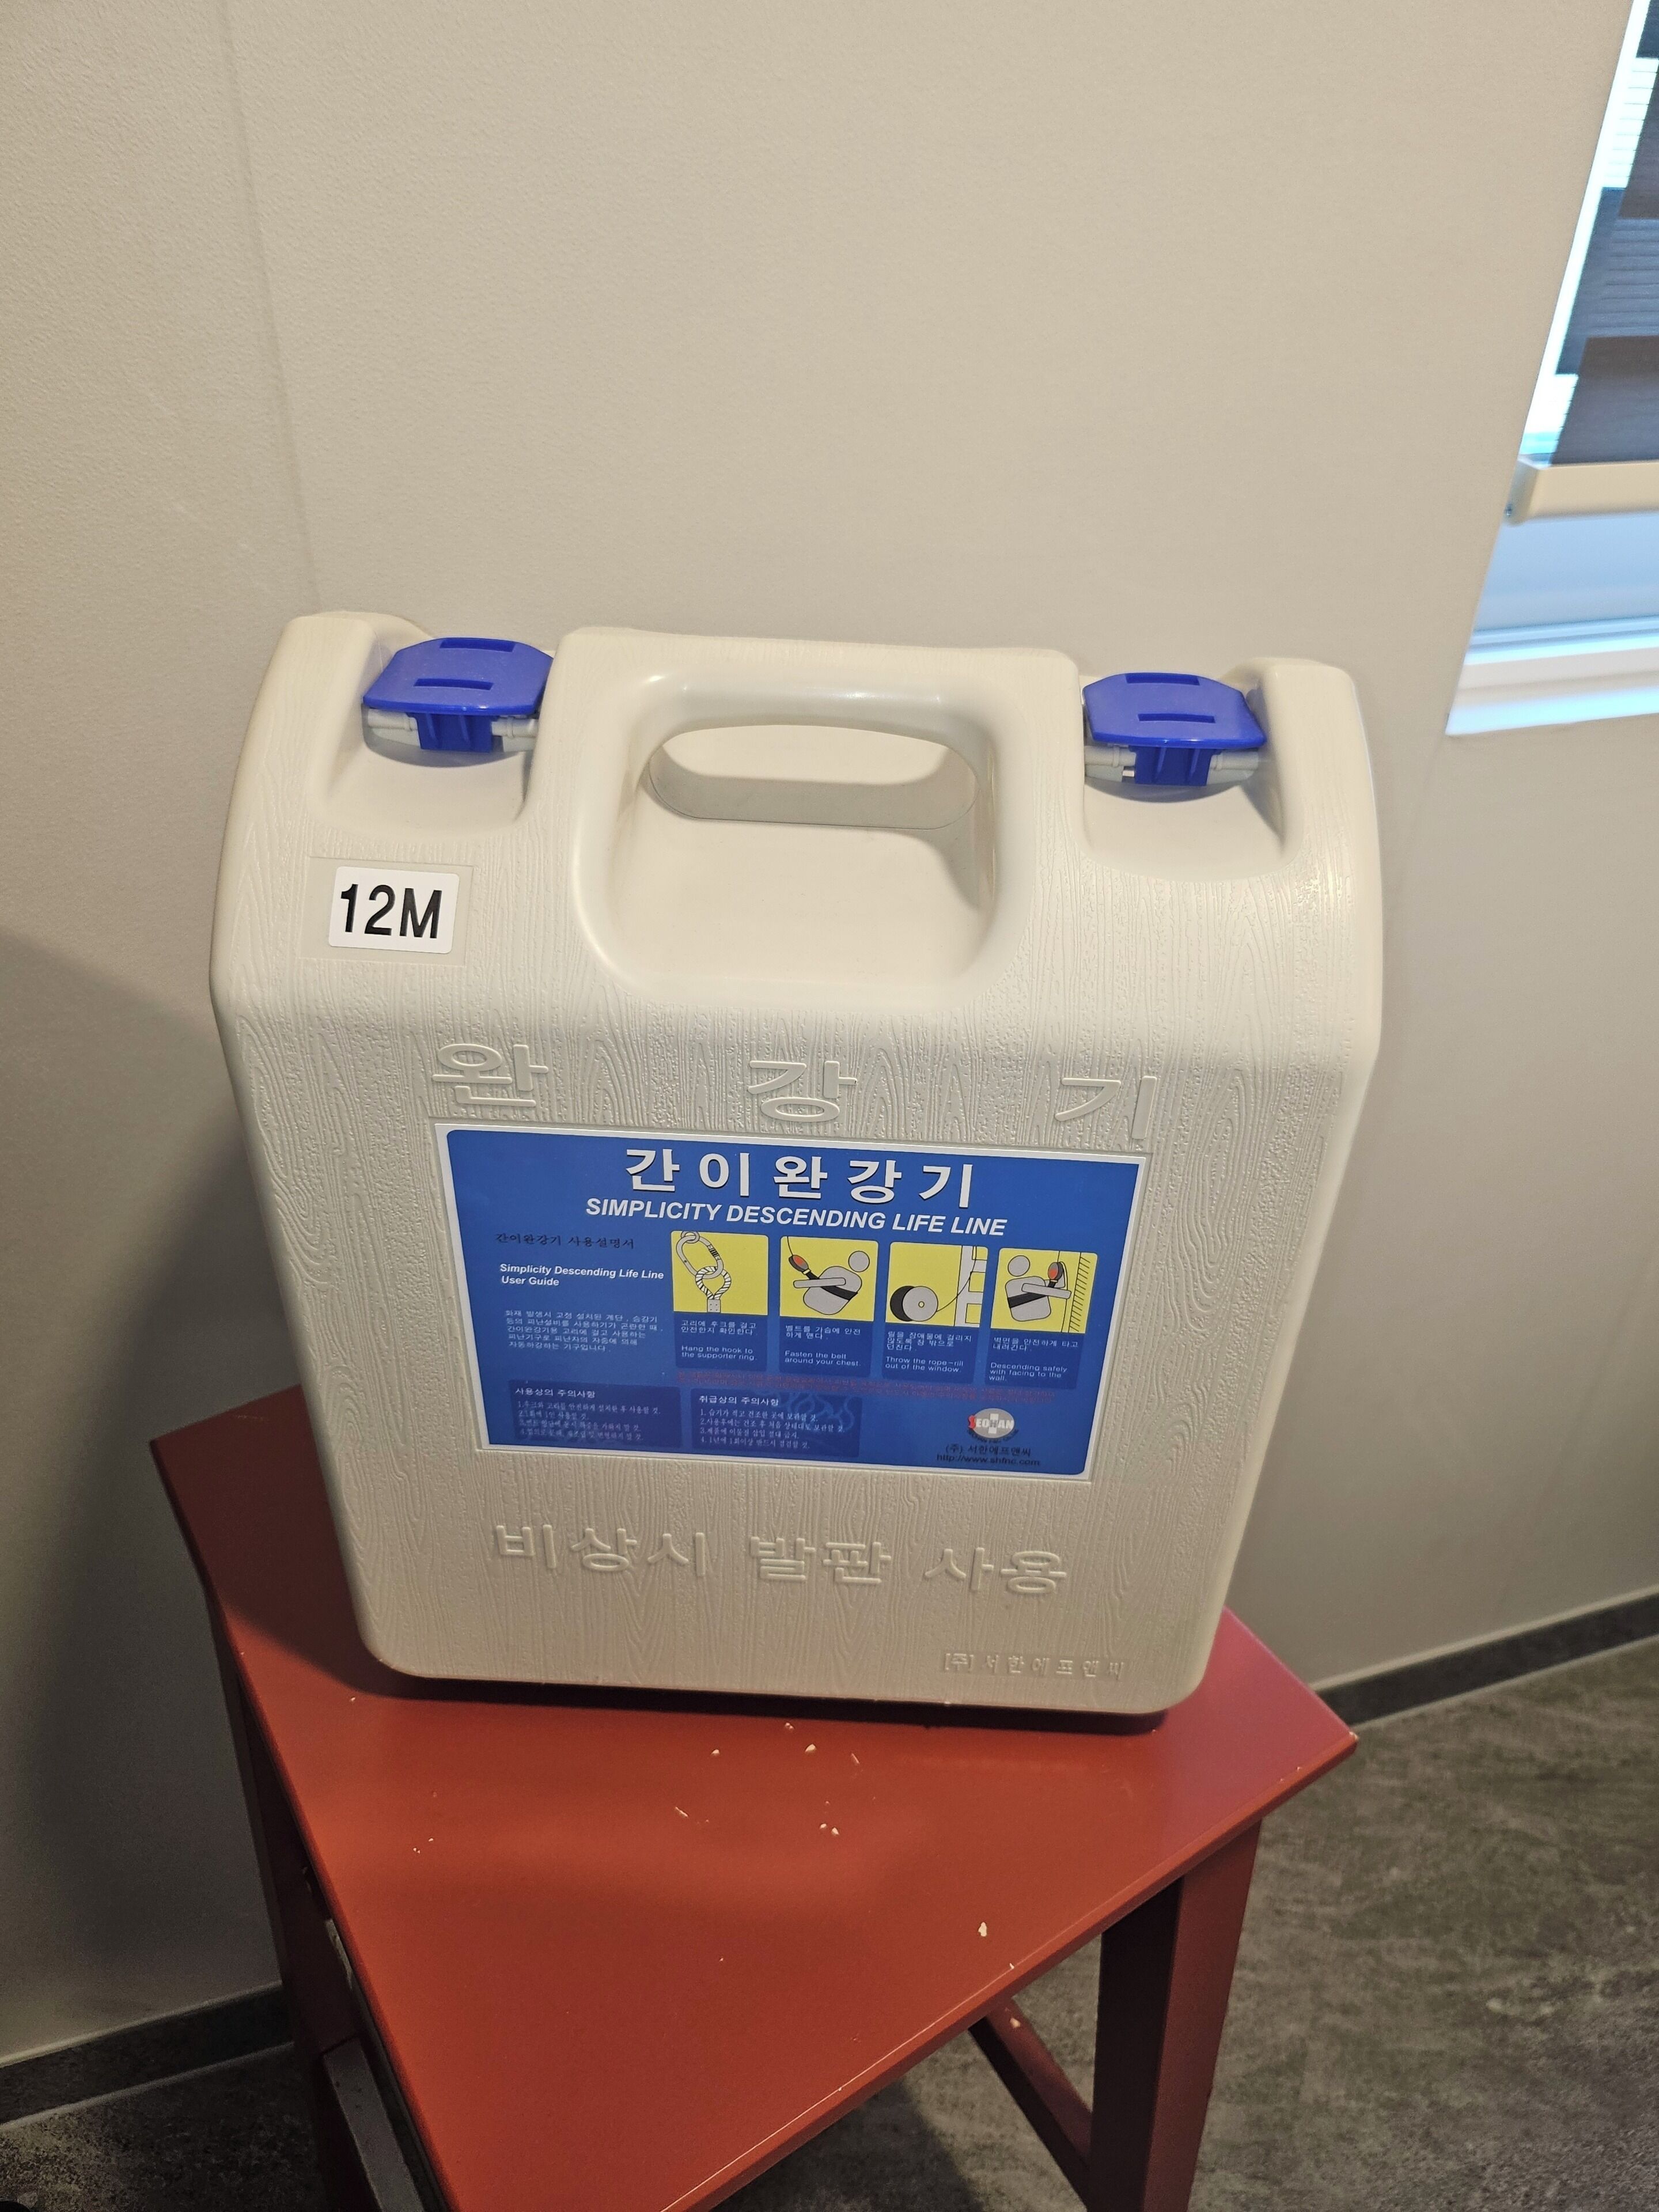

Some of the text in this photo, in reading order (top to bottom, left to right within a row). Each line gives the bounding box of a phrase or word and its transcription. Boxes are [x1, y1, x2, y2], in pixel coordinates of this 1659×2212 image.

[340, 884, 442, 939] 12M
[626, 1147, 975, 1209] 간이완강기
[585, 1197, 1007, 1236] SIMPLICITY DESCENDING LIFE LINE
[496, 1233, 634, 1249] 간이완강기 사용설명서
[500, 1263, 664, 1279] Simplicity Descending Life Line
[502, 1275, 560, 1286] User Guide
[947, 1334, 972, 1342] 걸리지
[1024, 1339, 1057, 1347] 안전하게
[991, 1362, 1040, 1371] Descending
[516, 1388, 595, 1398] 사용상의 주의사항
[699, 1395, 779, 1406] 취급상의 주의사항
[968, 1414, 1015, 1430] SEOHAN
[946, 1443, 1031, 1457] (주) 서한에프앤씨
[495, 1524, 1067, 1595] 비상시 발판 사용
